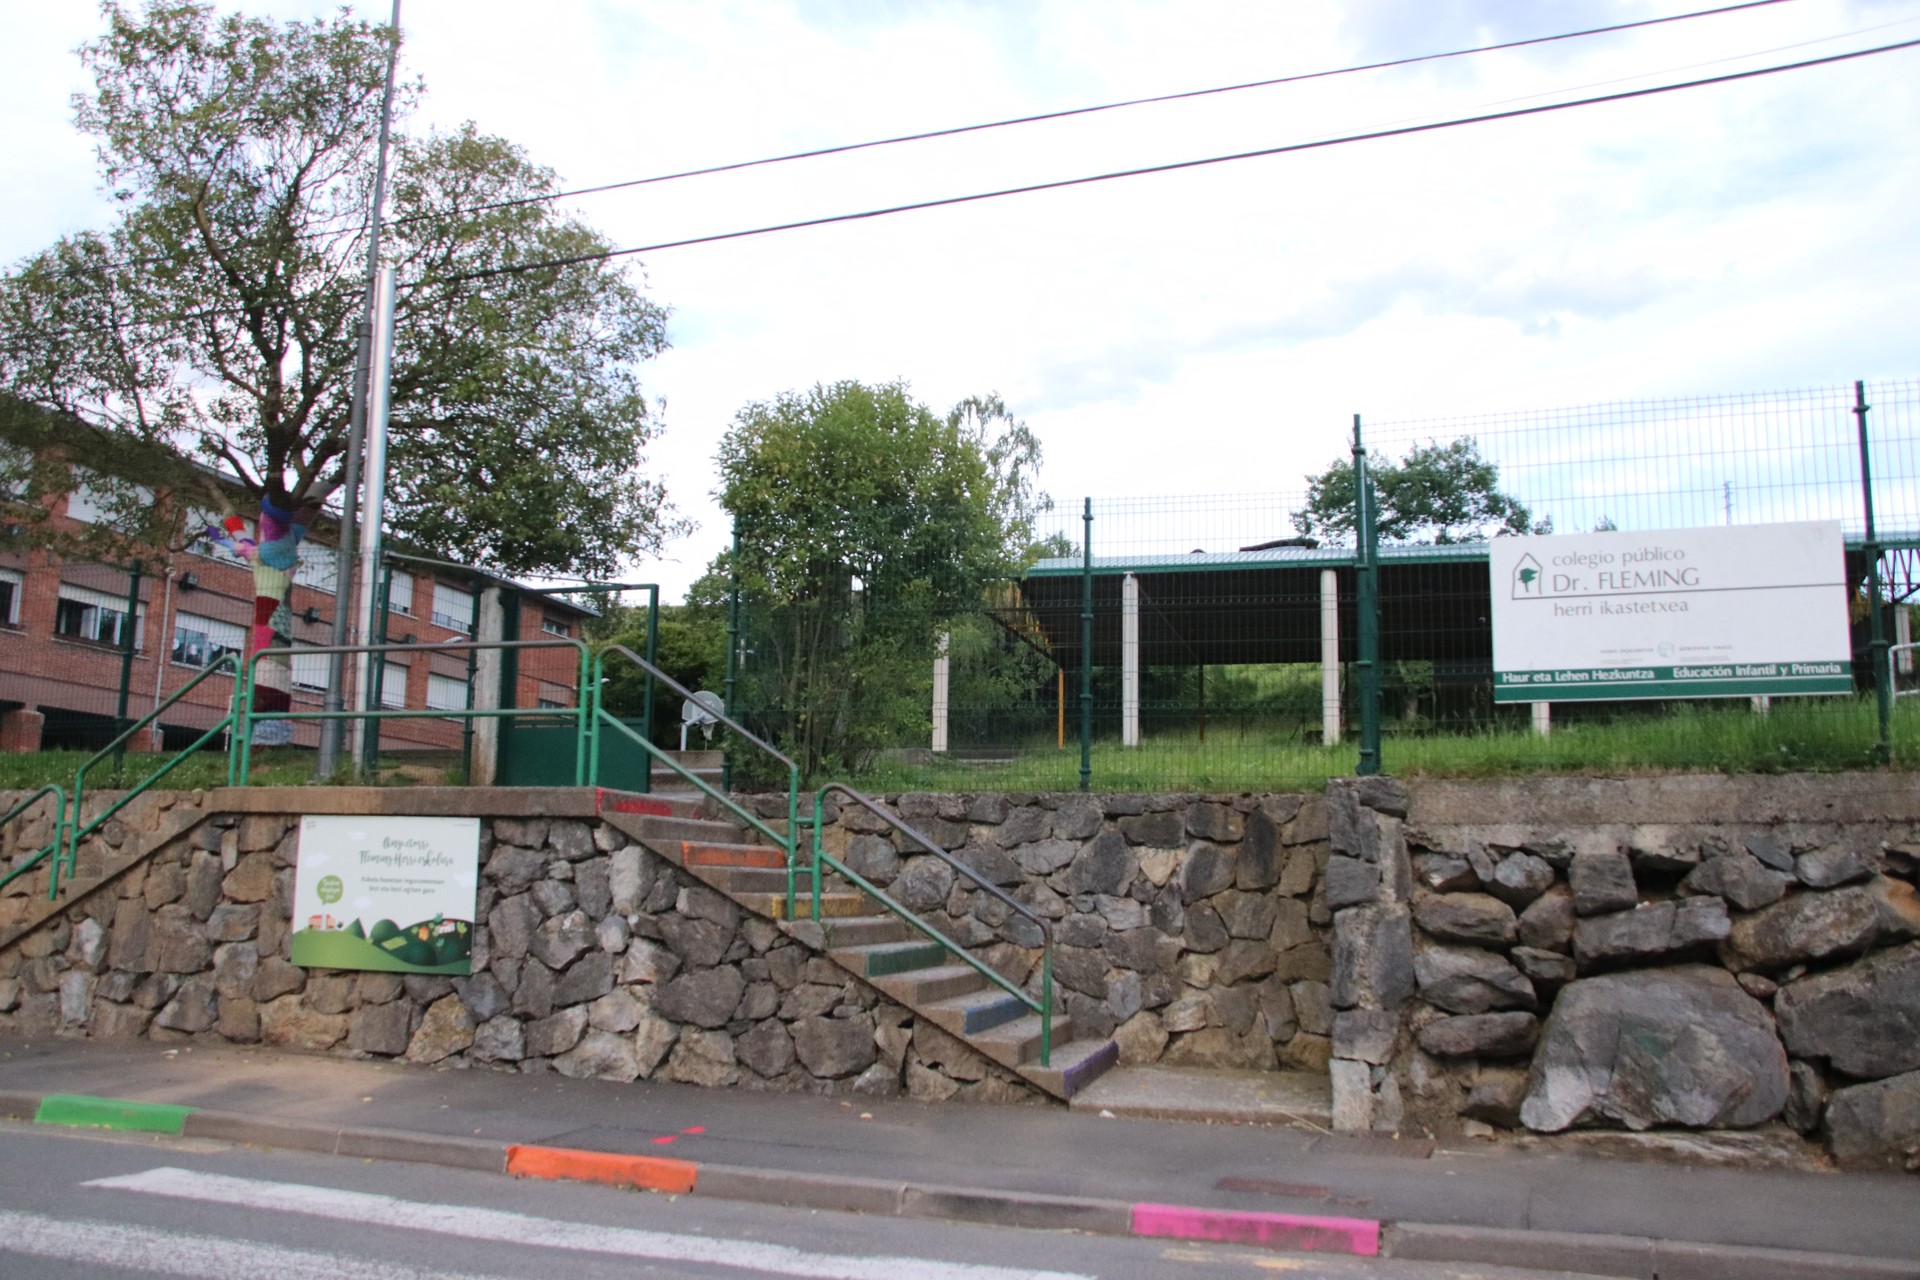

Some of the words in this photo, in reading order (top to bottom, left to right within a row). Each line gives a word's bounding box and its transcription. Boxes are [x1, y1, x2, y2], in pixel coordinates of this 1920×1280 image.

[1552, 551, 1615, 569] colegio
[1622, 547, 1685, 566] público
[1598, 567, 1699, 590] FLEMING
[1554, 601, 1593, 617] herri
[1600, 599, 1688, 615] ikastetxea
[1502, 672, 1531, 684] Haur
[1533, 672, 1552, 682] eta
[1554, 670, 1589, 682] Lehen
[1591, 668, 1655, 681] Hezkuntza
[1672, 666, 1733, 679] Educación
[1735, 664, 1777, 677] Infantil
[1780, 666, 1789, 677] y
[1791, 662, 1842, 675] Primaria
